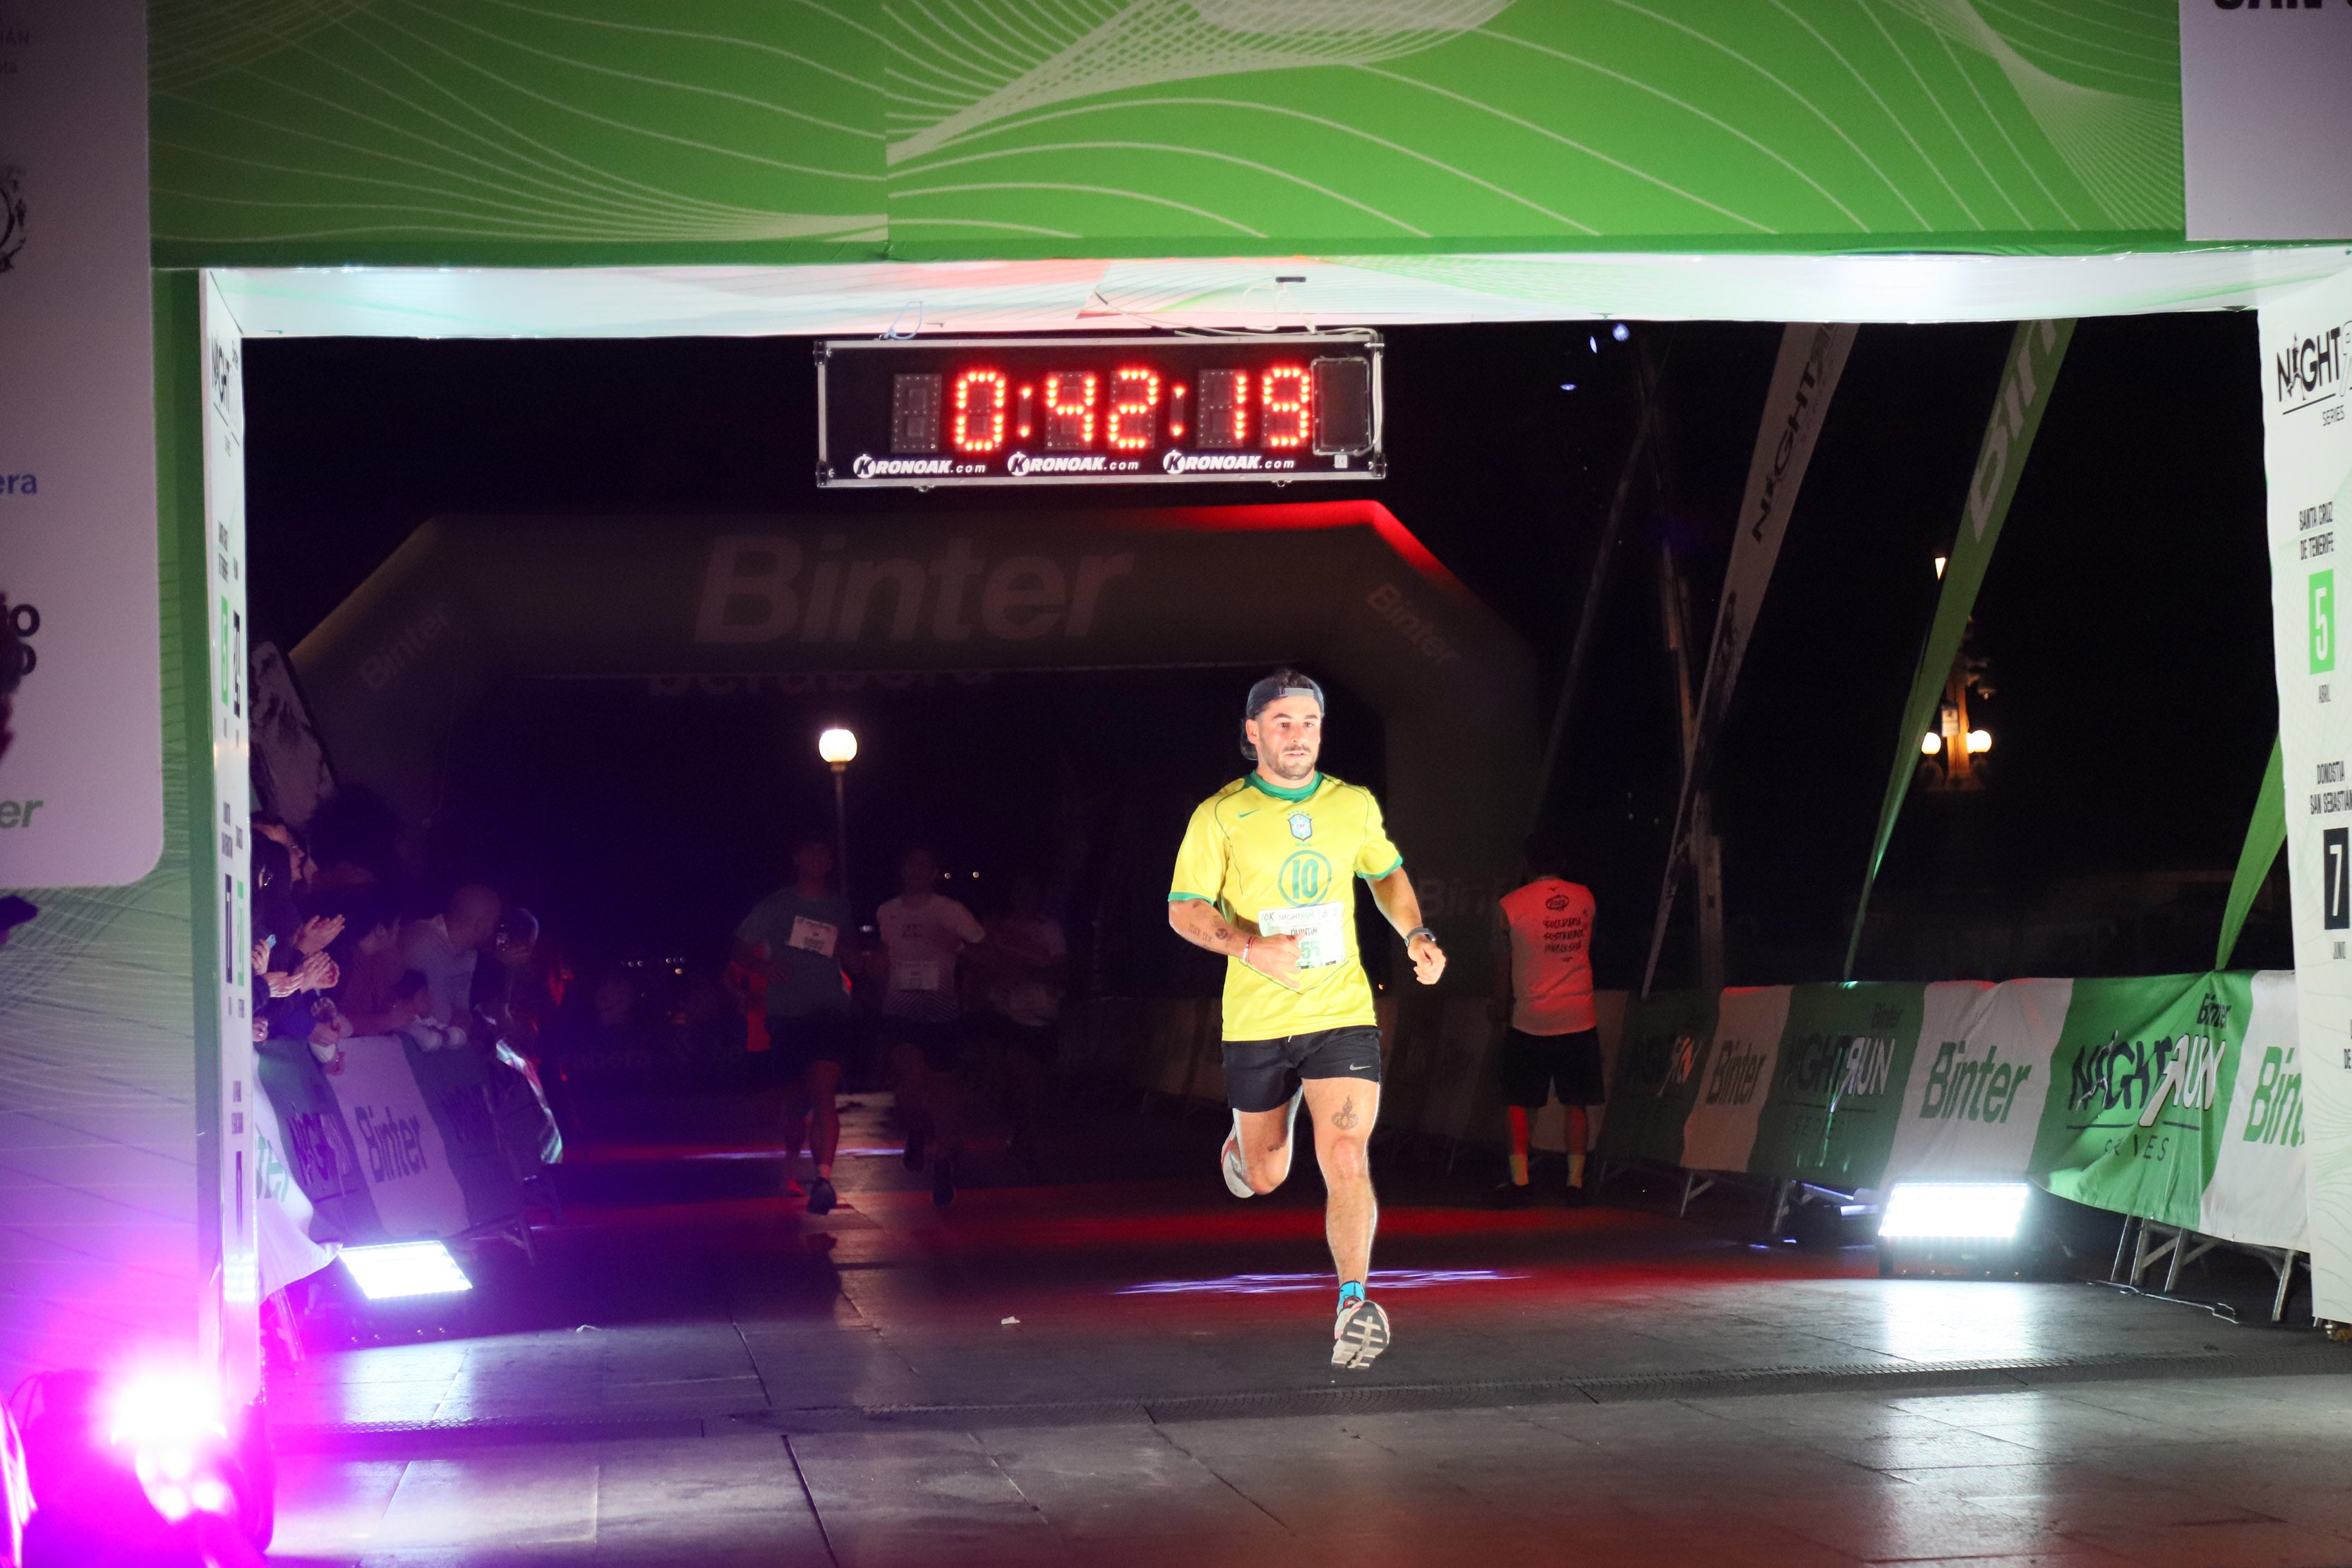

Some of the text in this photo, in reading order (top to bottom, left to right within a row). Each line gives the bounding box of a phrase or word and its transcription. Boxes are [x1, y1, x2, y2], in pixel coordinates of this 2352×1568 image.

[954, 366, 1313, 452] 0:42:19
[2322, 404, 2345, 426] SERIES
[853, 454, 987, 480] KRONOAK.com
[1007, 451, 1140, 477] KRONOAK.com
[1163, 449, 1296, 475] KRONOAK.com
[2300, 501, 2334, 531] SANTA CRUZ
[2300, 531, 2334, 560] DE TENERIFE
[693, 534, 1135, 644] Binter
[2315, 587, 2328, 661] 5
[2317, 761, 2345, 785] DONOSTIA
[2310, 793, 2322, 815] SAN
[1291, 859, 1319, 900] 10
[2330, 844, 2343, 916] 7
[1261, 912, 1275, 922] 10K
[1296, 940, 1321, 960] 55
[2196, 992, 2232, 1029] Binter
[1706, 1041, 1767, 1105] Binter
[1919, 1041, 2032, 1124] Binter
[354, 1105, 429, 1183] Binter
